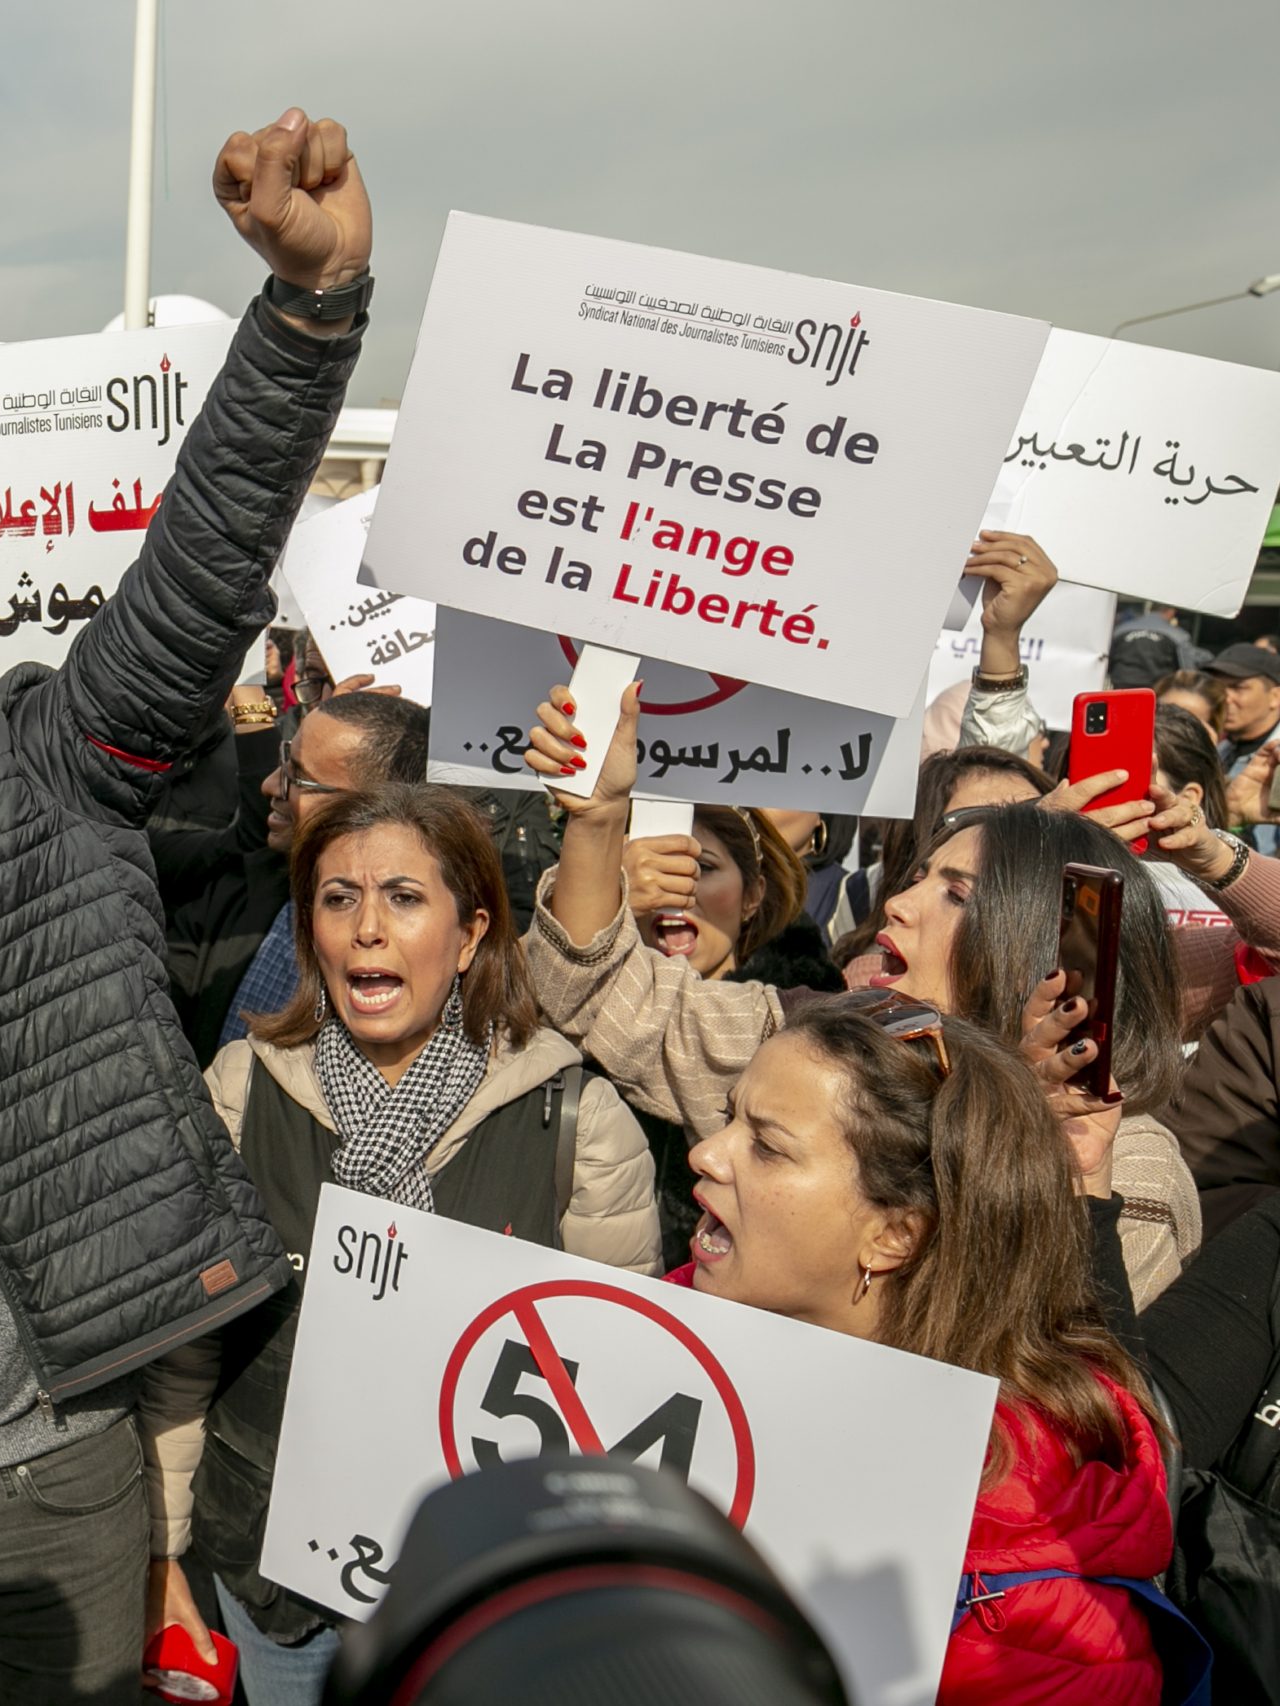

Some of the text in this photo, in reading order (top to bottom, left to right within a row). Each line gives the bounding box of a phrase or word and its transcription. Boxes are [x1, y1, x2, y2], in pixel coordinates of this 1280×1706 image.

[578, 301, 787, 357] Syndicat National des Journalistes Tunisiens
[584, 283, 794, 335] النقابة الوطنية للصحفيين التونسيين
[787, 310, 870, 387] snjt
[2, 389, 56, 413] الوطنية
[53, 412, 103, 433] Tunisiens
[59, 385, 102, 408] النقابة
[106, 353, 188, 446] snjt
[510, 352, 880, 466] La liberté de
[544, 423, 822, 518] La Presse
[1003, 429, 1260, 505] حرية التعبير
[516, 488, 795, 577] est l'ange
[462, 531, 831, 650] de la Liberté.
[333, 1221, 409, 1301] snjt
